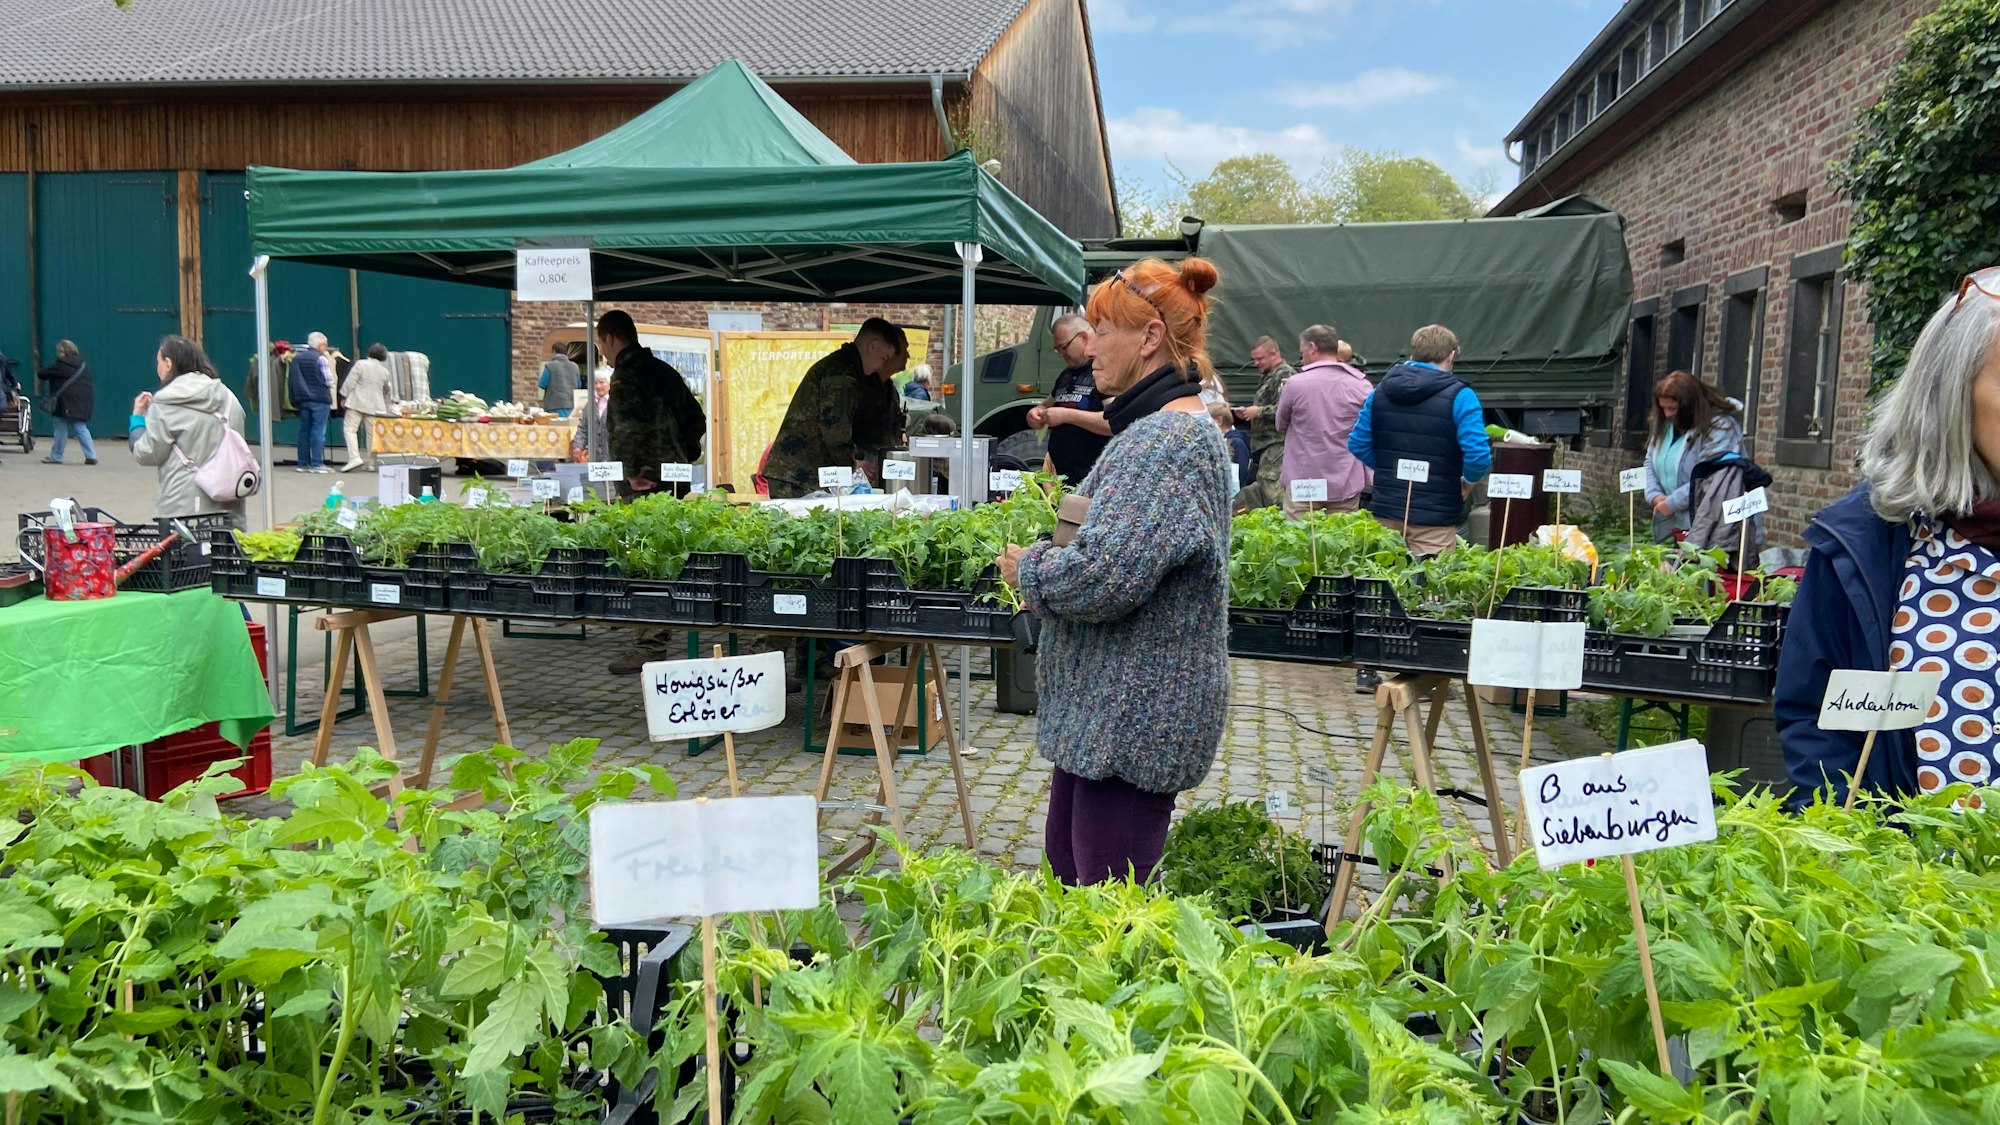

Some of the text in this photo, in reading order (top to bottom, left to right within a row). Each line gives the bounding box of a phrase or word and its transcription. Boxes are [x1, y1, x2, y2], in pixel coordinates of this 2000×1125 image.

[525, 255, 581, 268] Kaffeepreis
[538, 273, 568, 284] 0,80€
[750, 350, 829, 361] TIERPORTRÄT
[655, 667, 764, 699] Honigsüßer
[668, 699, 742, 724] Erlöser
[1540, 773, 1628, 804] B aus
[1541, 798, 1698, 848] Siebenbürgen
